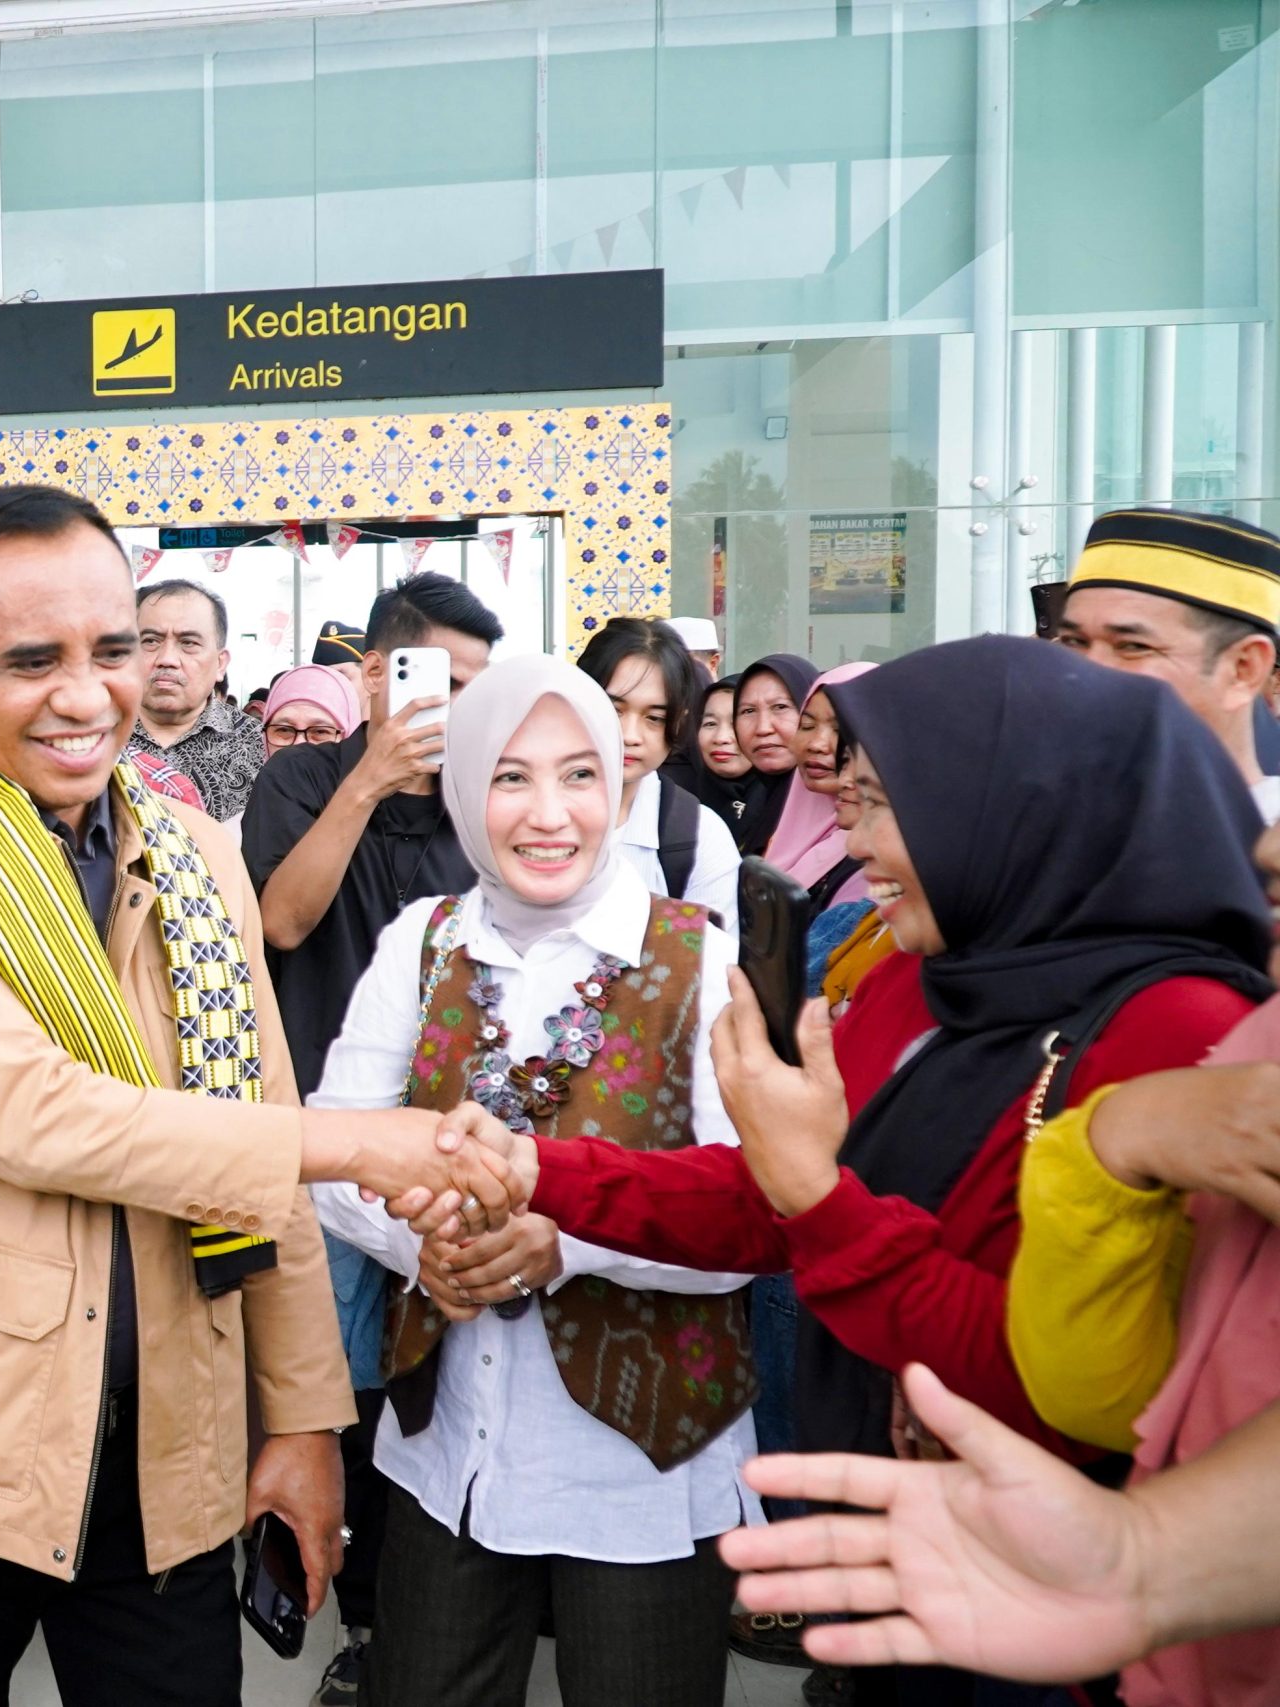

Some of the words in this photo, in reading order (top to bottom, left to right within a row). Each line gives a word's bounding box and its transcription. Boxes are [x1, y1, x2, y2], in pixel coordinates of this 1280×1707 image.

[227, 300, 468, 341] Kedatangan
[228, 360, 344, 391] Arrivals
[221, 528, 246, 538] Toilet
